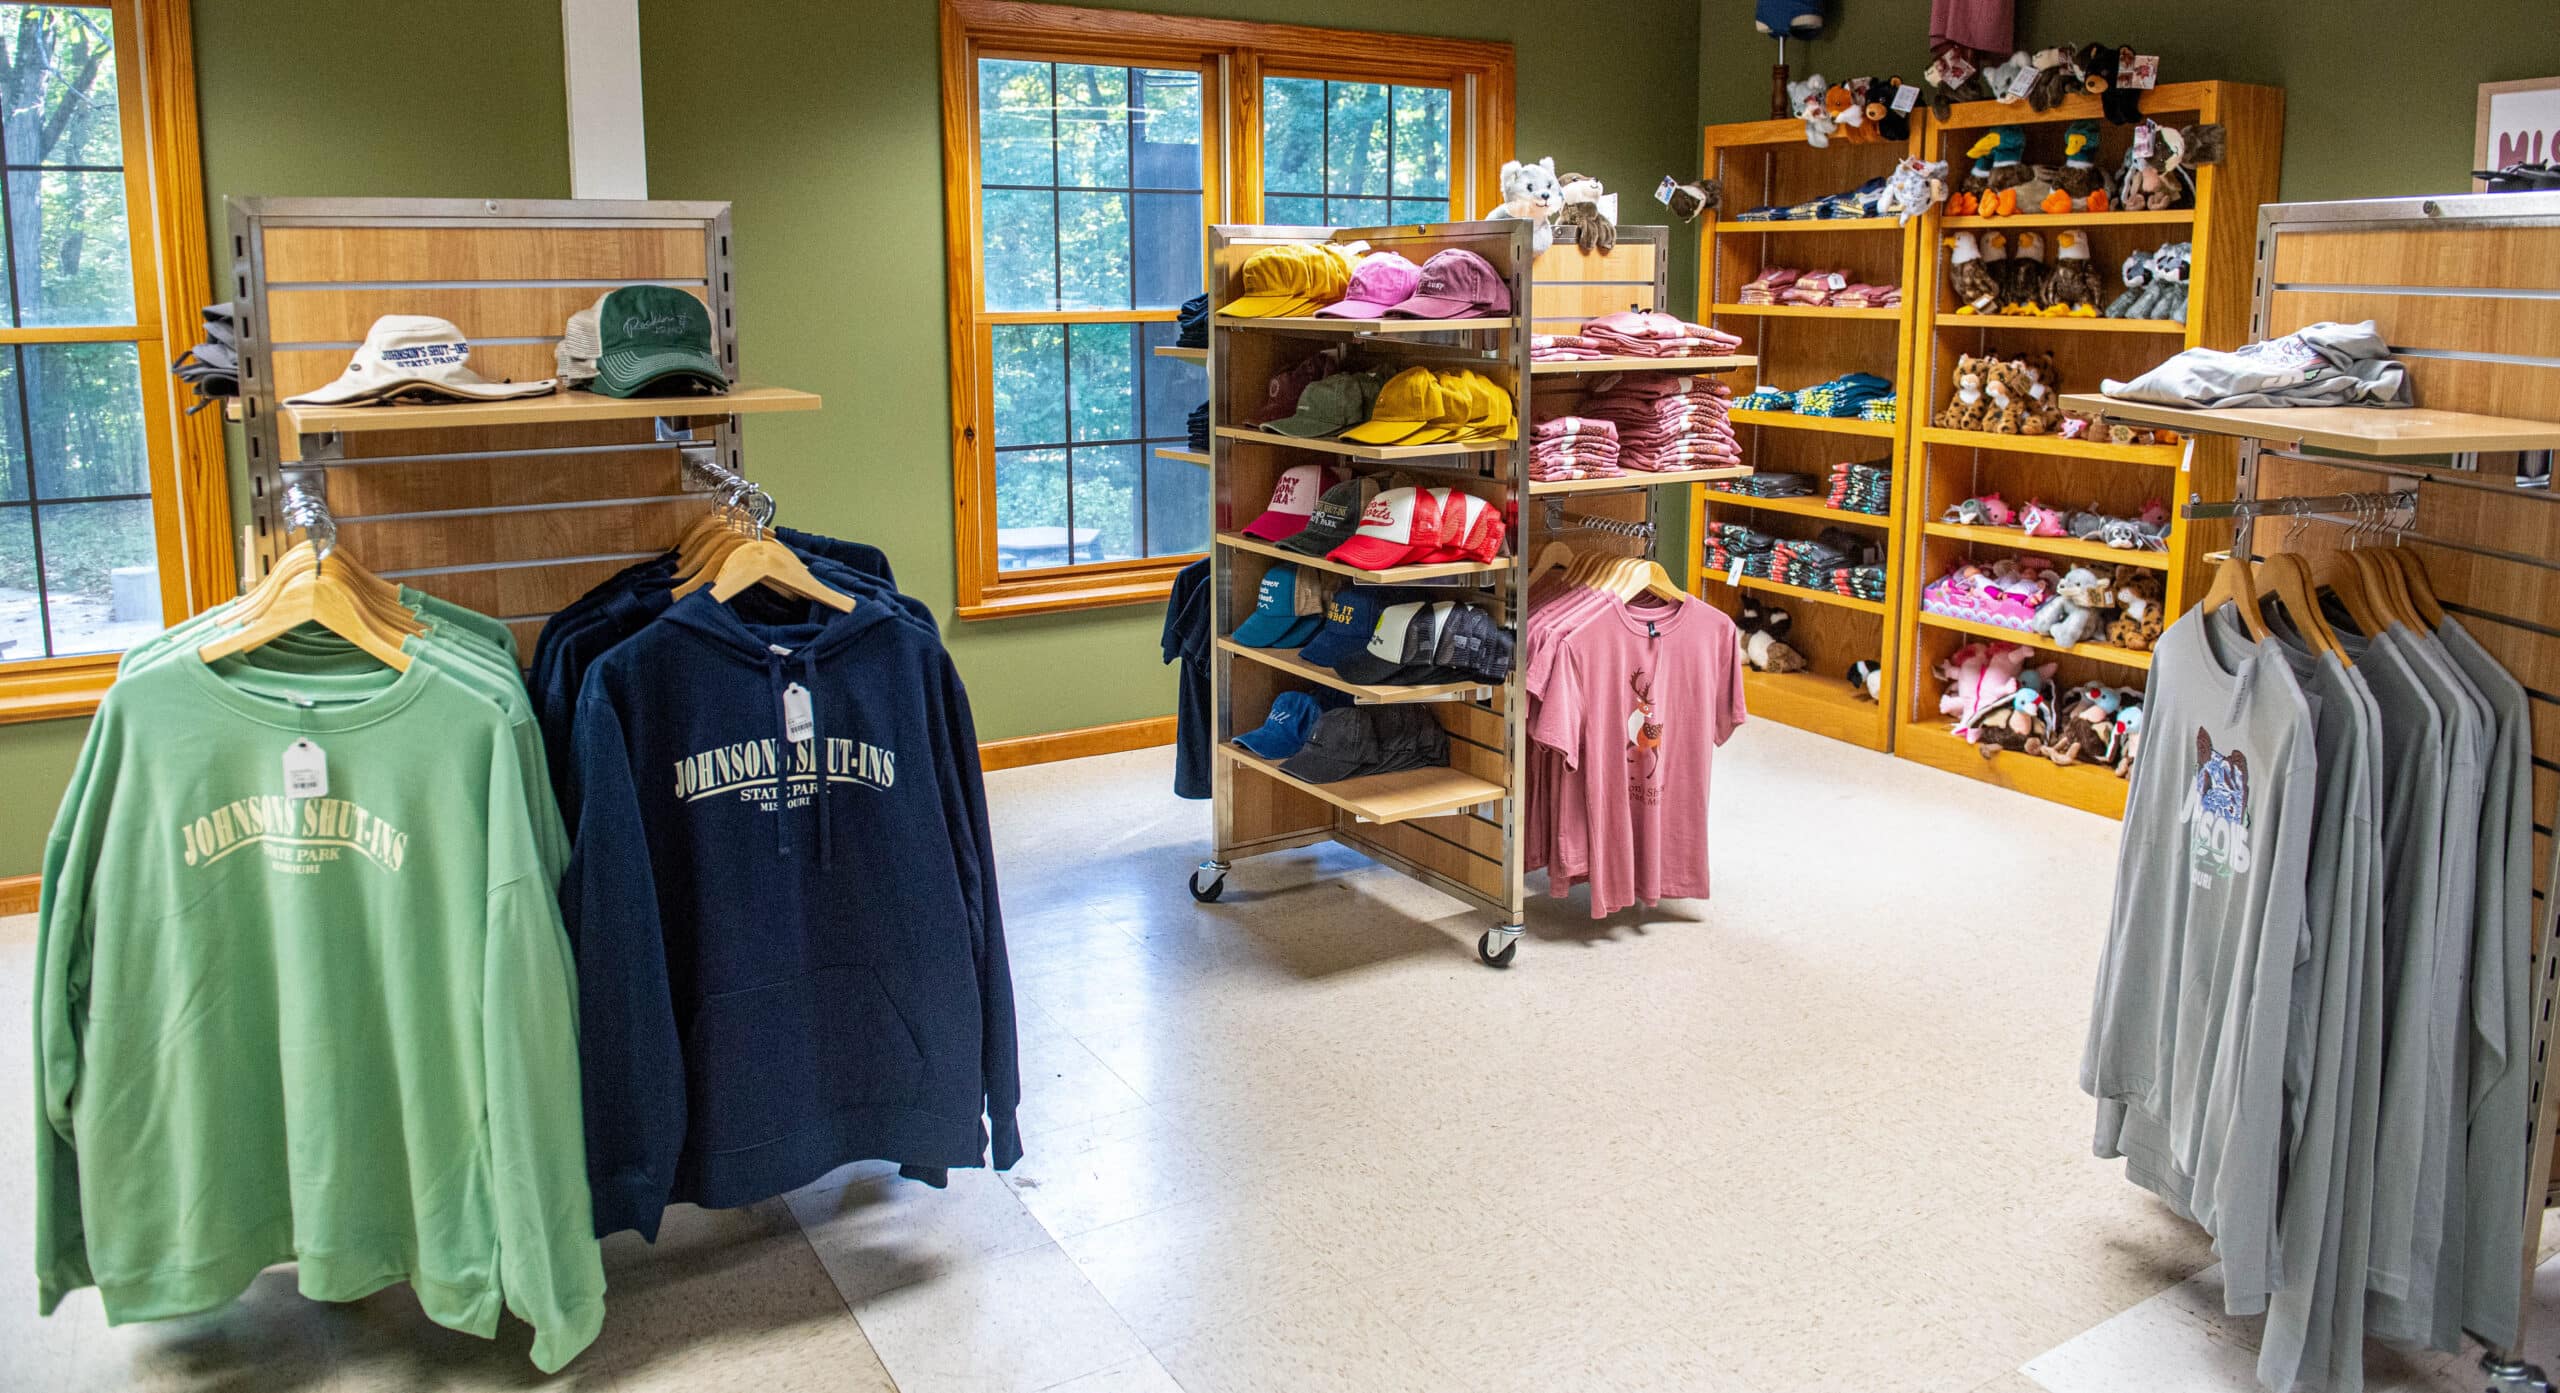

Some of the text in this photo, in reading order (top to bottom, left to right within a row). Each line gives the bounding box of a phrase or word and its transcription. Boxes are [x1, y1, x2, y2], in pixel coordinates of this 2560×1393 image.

[395, 355, 462, 368] STATE PARK
[673, 737, 790, 799] JOHNSON
[739, 782, 832, 802] STAT PAR
[759, 796, 811, 812] MISOURI
[296, 847, 341, 862] PARK
